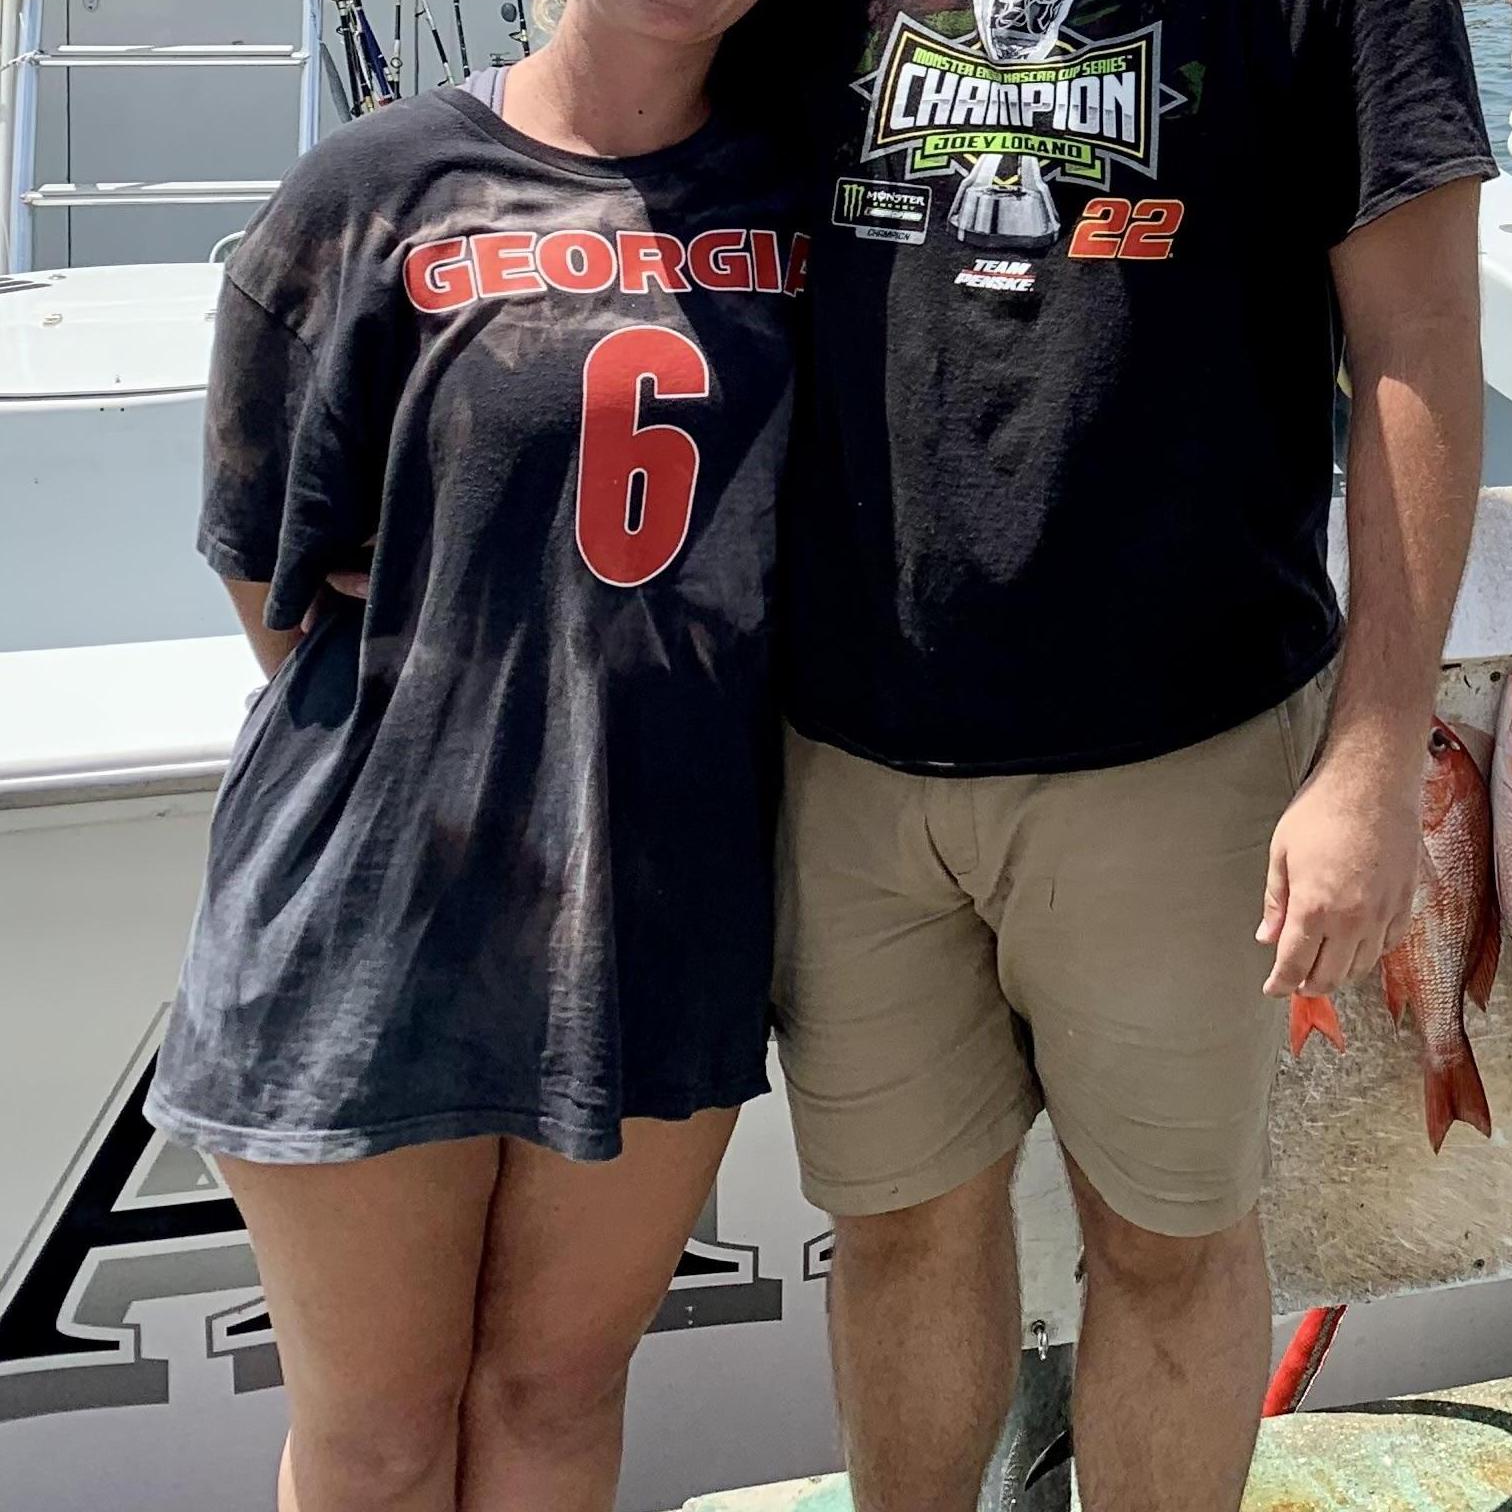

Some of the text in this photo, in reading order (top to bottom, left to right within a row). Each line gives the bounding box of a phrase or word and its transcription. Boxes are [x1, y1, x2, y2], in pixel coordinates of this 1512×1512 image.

[911, 47, 974, 77] MONSTER
[1003, 70, 1057, 84] NASCAR
[1058, 66, 1081, 81] CUP
[1081, 56, 1127, 76] SERIES
[889, 62, 1136, 143] CHAMPION
[934, 135, 1082, 158] JOEY LOGANO
[1067, 197, 1184, 259] 22
[954, 272, 1036, 291] PENSKE
[973, 258, 1032, 275] TEAM
[575, 325, 709, 588] 6
